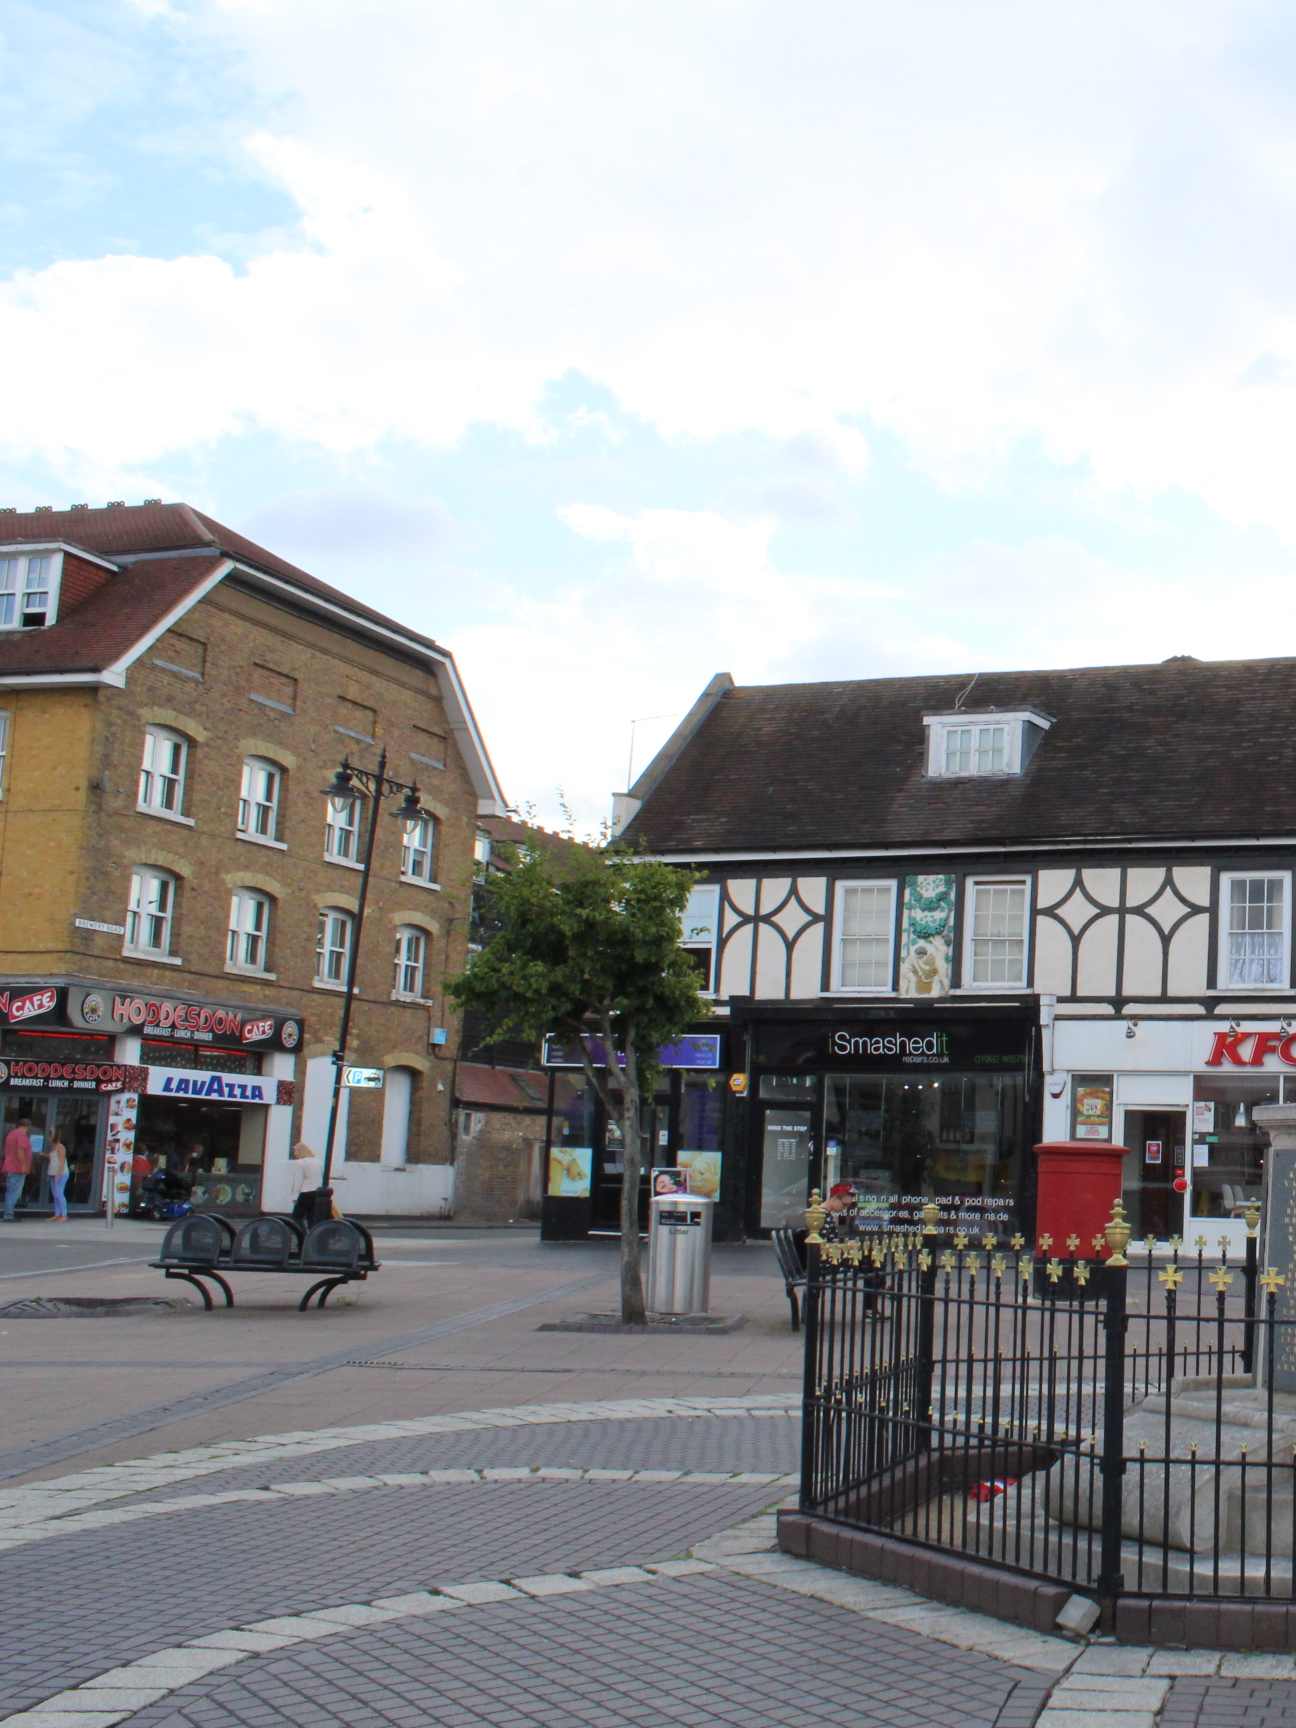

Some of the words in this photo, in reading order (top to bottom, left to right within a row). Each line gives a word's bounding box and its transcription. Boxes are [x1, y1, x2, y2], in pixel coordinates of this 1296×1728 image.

[12, 991, 53, 1017] CAFE
[112, 995, 242, 1036] HODDESDON
[143, 1024, 172, 1037] BREAKFAST
[174, 1028, 191, 1039] LUNCH
[194, 1030, 213, 1042] DINNER
[244, 1020, 273, 1040] CAFE
[902, 1055, 950, 1064] repairs.co.uk
[10, 1061, 126, 1081] HODDESDON
[10, 1077, 44, 1087] BREAKFAST
[48, 1079, 69, 1088] LUNCH
[73, 1080, 97, 1090] DINNER
[101, 1081, 123, 1090] CAFE
[162, 1075, 265, 1101] LAVAZZA
